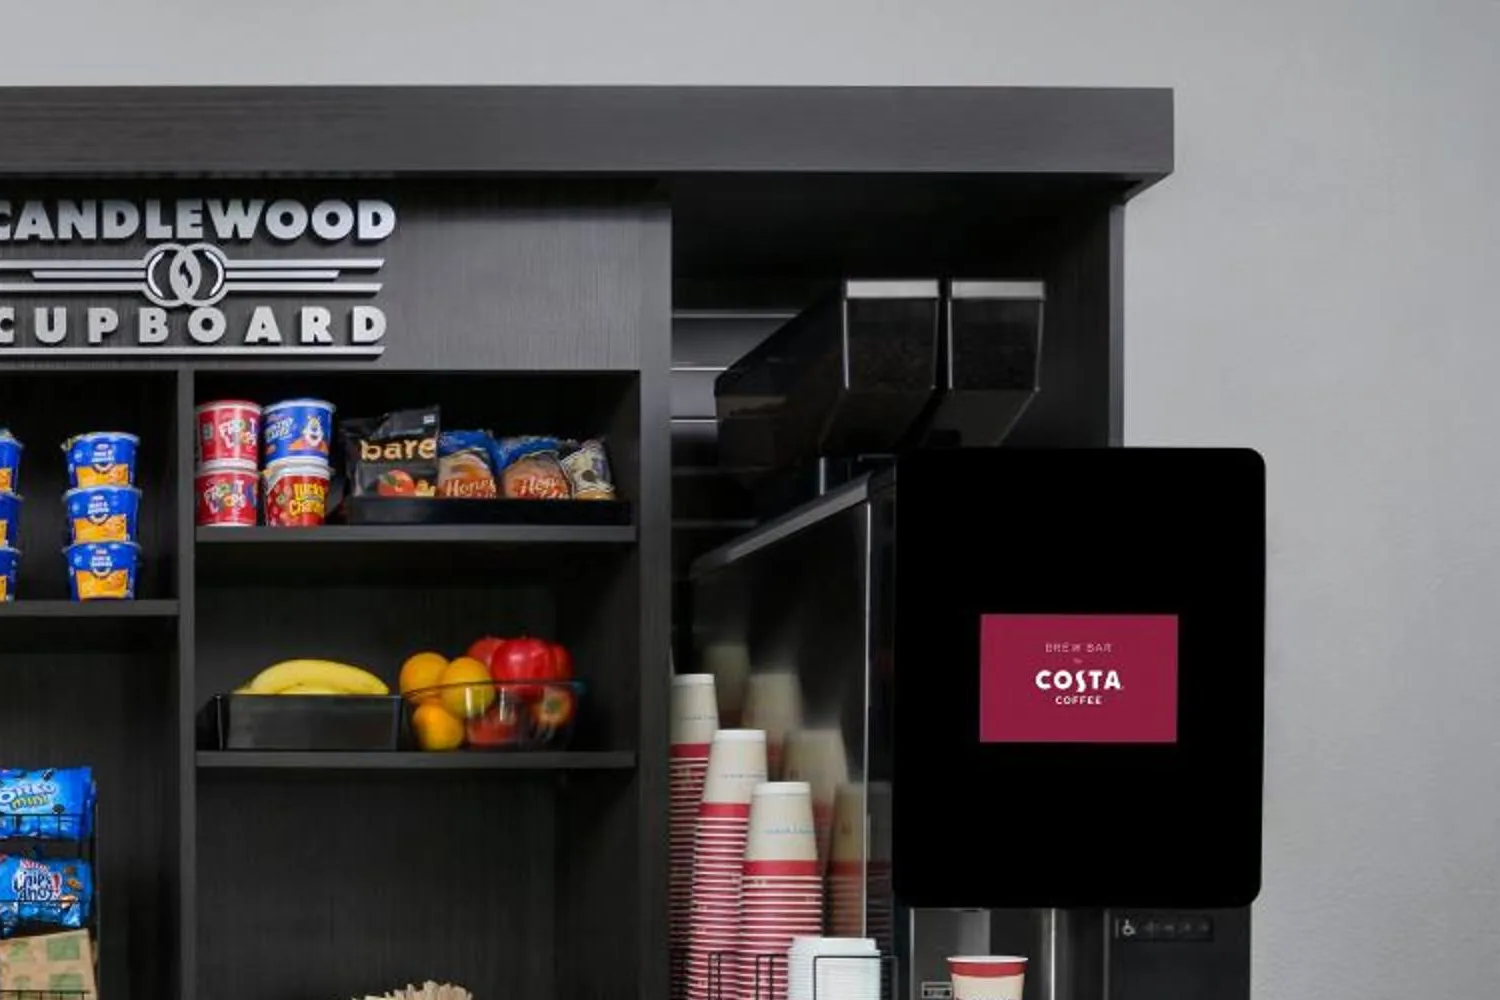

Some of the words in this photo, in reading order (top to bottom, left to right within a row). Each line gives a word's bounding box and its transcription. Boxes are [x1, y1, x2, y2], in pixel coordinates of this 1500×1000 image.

[360, 438, 437, 461] bare
[1035, 669, 1121, 692] COSTA
[1055, 695, 1103, 705] COFFEE
